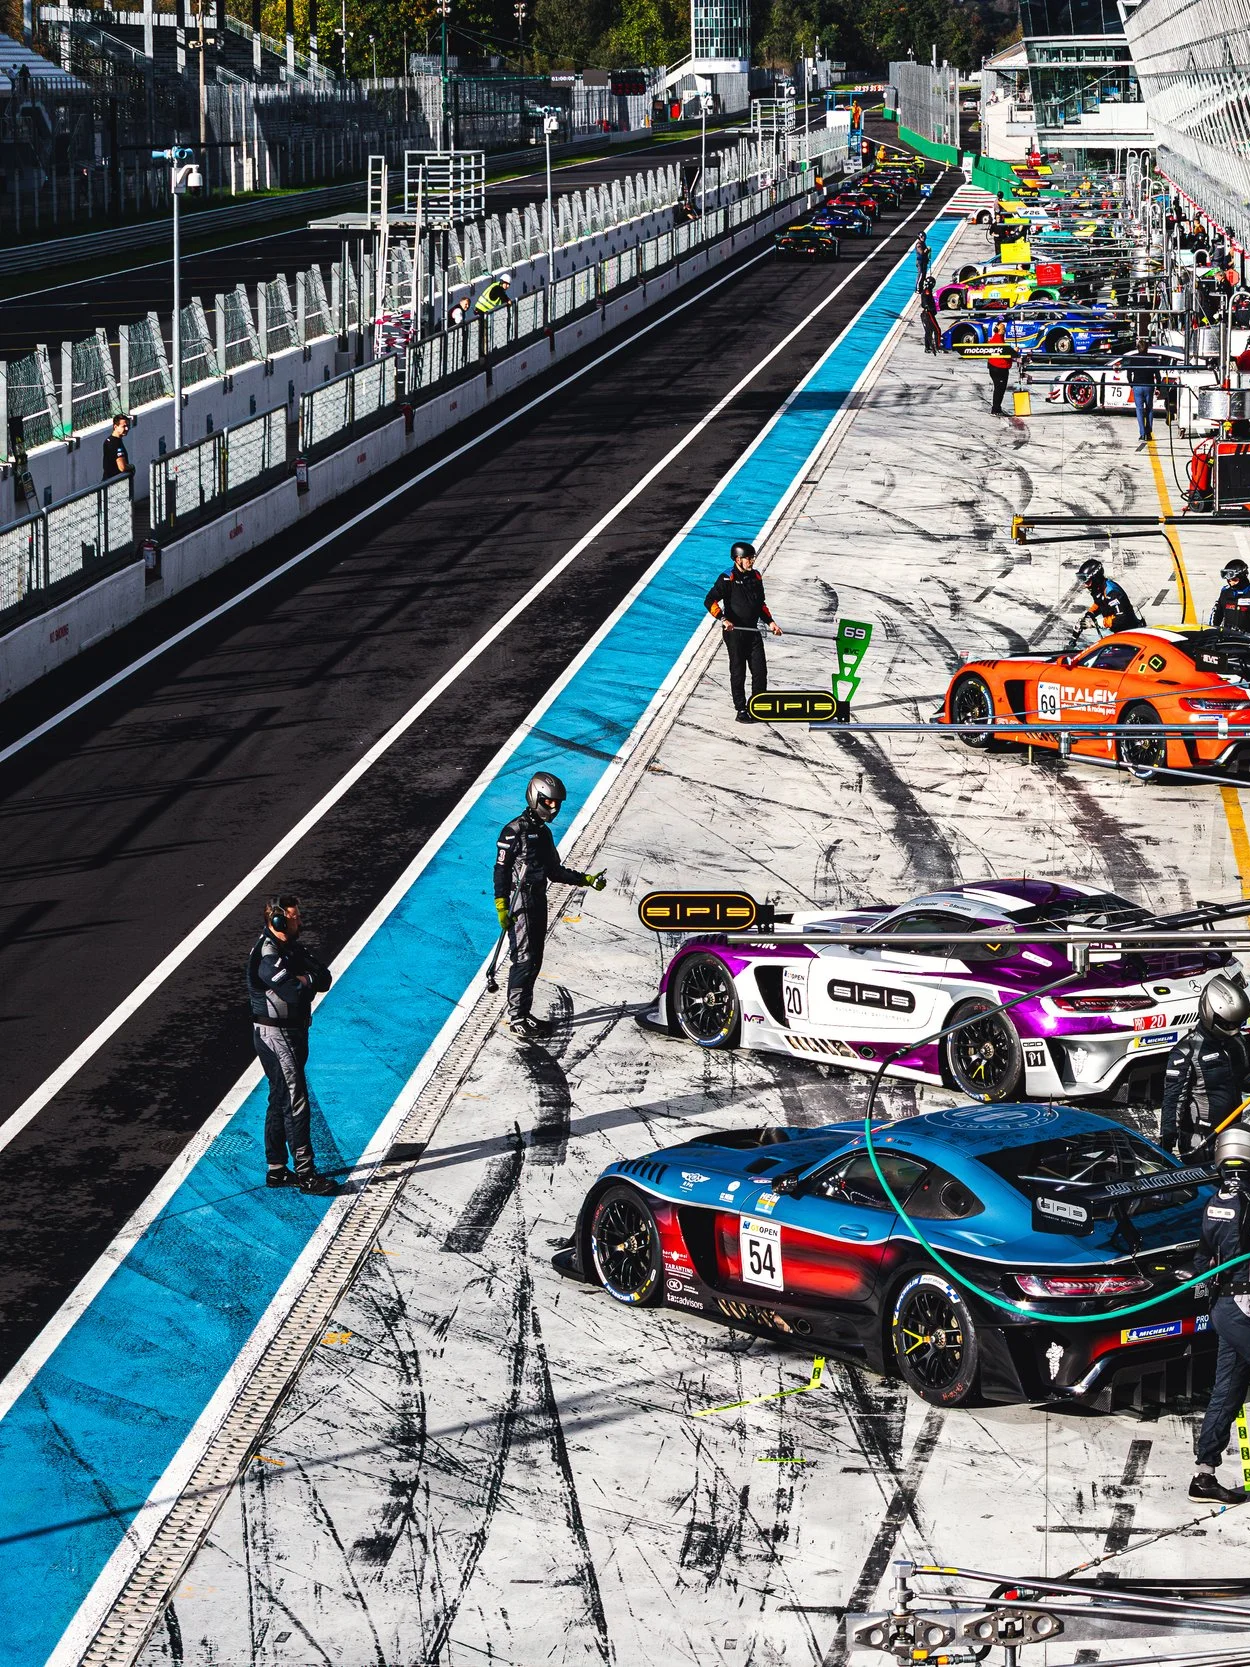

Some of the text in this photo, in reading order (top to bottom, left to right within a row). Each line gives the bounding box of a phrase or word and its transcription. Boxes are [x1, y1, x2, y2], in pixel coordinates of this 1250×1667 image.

[1111, 387, 1122, 398] 75
[844, 626, 866, 639] 69
[1041, 694, 1056, 715] 69
[498, 849, 506, 862] 3
[785, 987, 802, 1015] 20
[1134, 1015, 1164, 1030] PRO 20
[1147, 1035, 1174, 1044] MICHELIN
[749, 1240, 776, 1280] 54
[665, 1262, 693, 1275] TARANTINO
[1195, 1315, 1209, 1324] PRO
[1139, 1325, 1175, 1337] MICHELIN
[1196, 1323, 1208, 1331] AM
